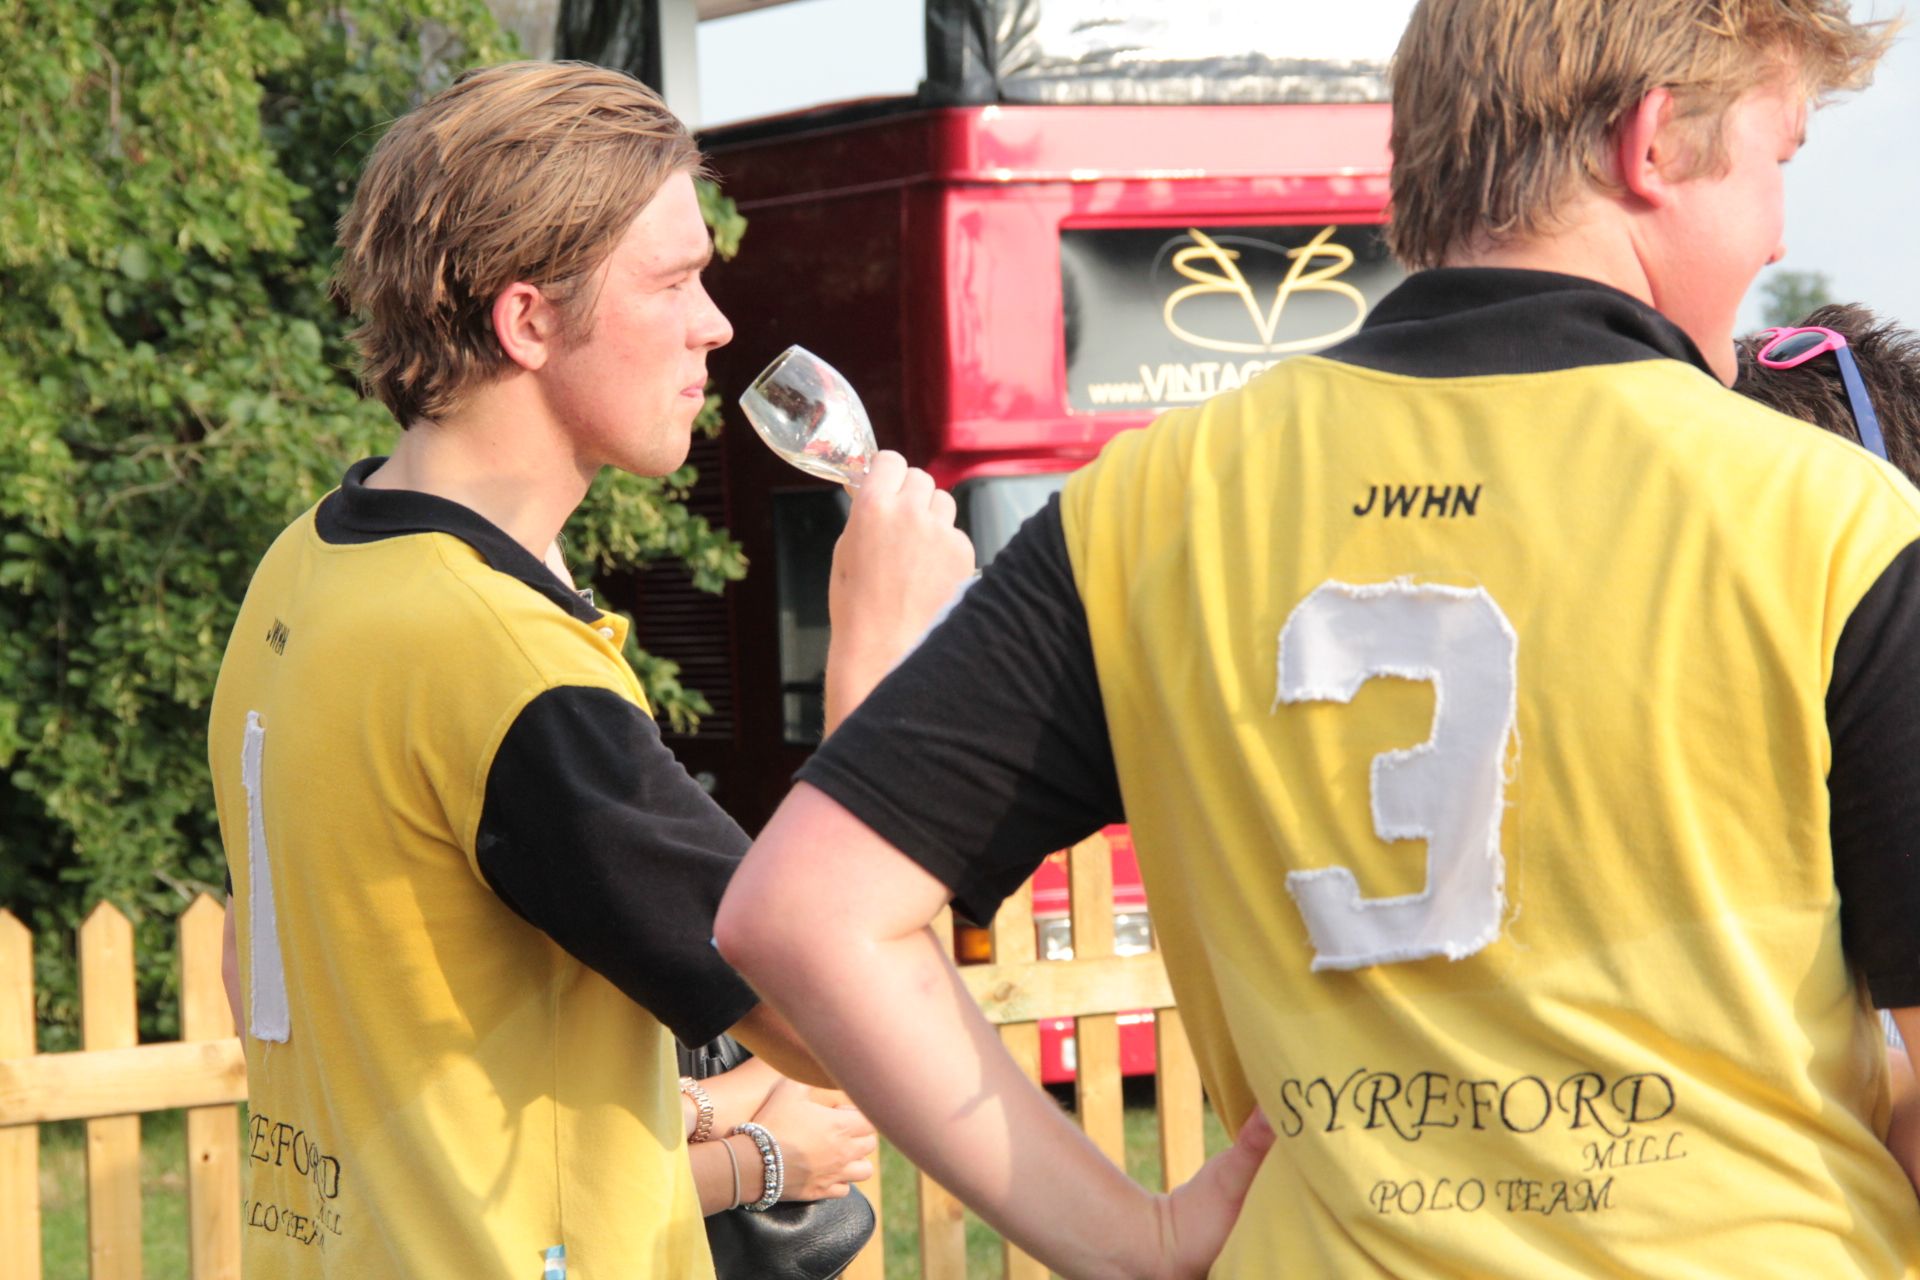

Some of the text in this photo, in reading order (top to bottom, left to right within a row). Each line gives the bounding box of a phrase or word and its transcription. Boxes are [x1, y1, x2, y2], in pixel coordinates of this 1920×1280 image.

[1087, 360, 1281, 403] www.VINTAG
[1353, 483, 1482, 518] JWHN
[1278, 575, 1518, 971] 3
[241, 710, 291, 1043] 1
[1280, 1068, 1676, 1141] SYREFORD
[248, 1113, 341, 1203] EFORD
[1582, 1132, 1688, 1172] MILL
[1369, 1177, 1616, 1215] POLO TEAM
